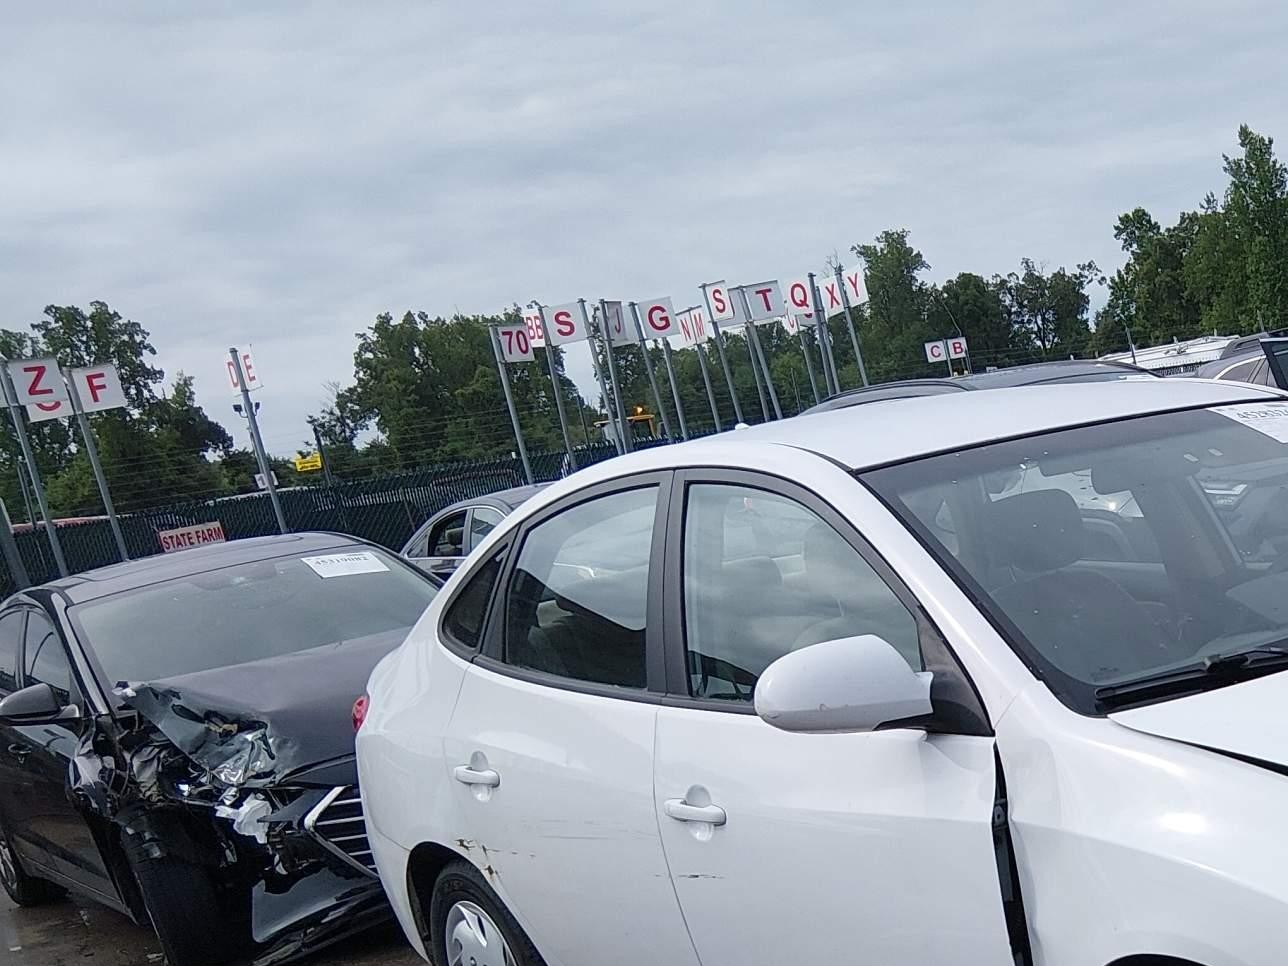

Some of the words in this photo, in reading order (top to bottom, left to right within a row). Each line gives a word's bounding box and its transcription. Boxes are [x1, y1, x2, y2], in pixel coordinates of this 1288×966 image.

[790, 283, 809, 308] Q
[825, 283, 840, 309] X
[847, 272, 859, 297] Y
[712, 289, 726, 313] S
[755, 288, 772, 312] T
[526, 315, 544, 340] BB
[554, 311, 575, 336] S
[647, 305, 671, 331] G
[680, 318, 692, 342] N
[693, 313, 705, 337] M
[501, 330, 529, 355] 70
[930, 345, 942, 358] C
[952, 341, 964, 354] B
[243, 354, 256, 382] E
[23, 366, 54, 396] Z
[86, 372, 107, 403] F
[162, 532, 195, 550] STATE
[195, 526, 225, 544] FARM
